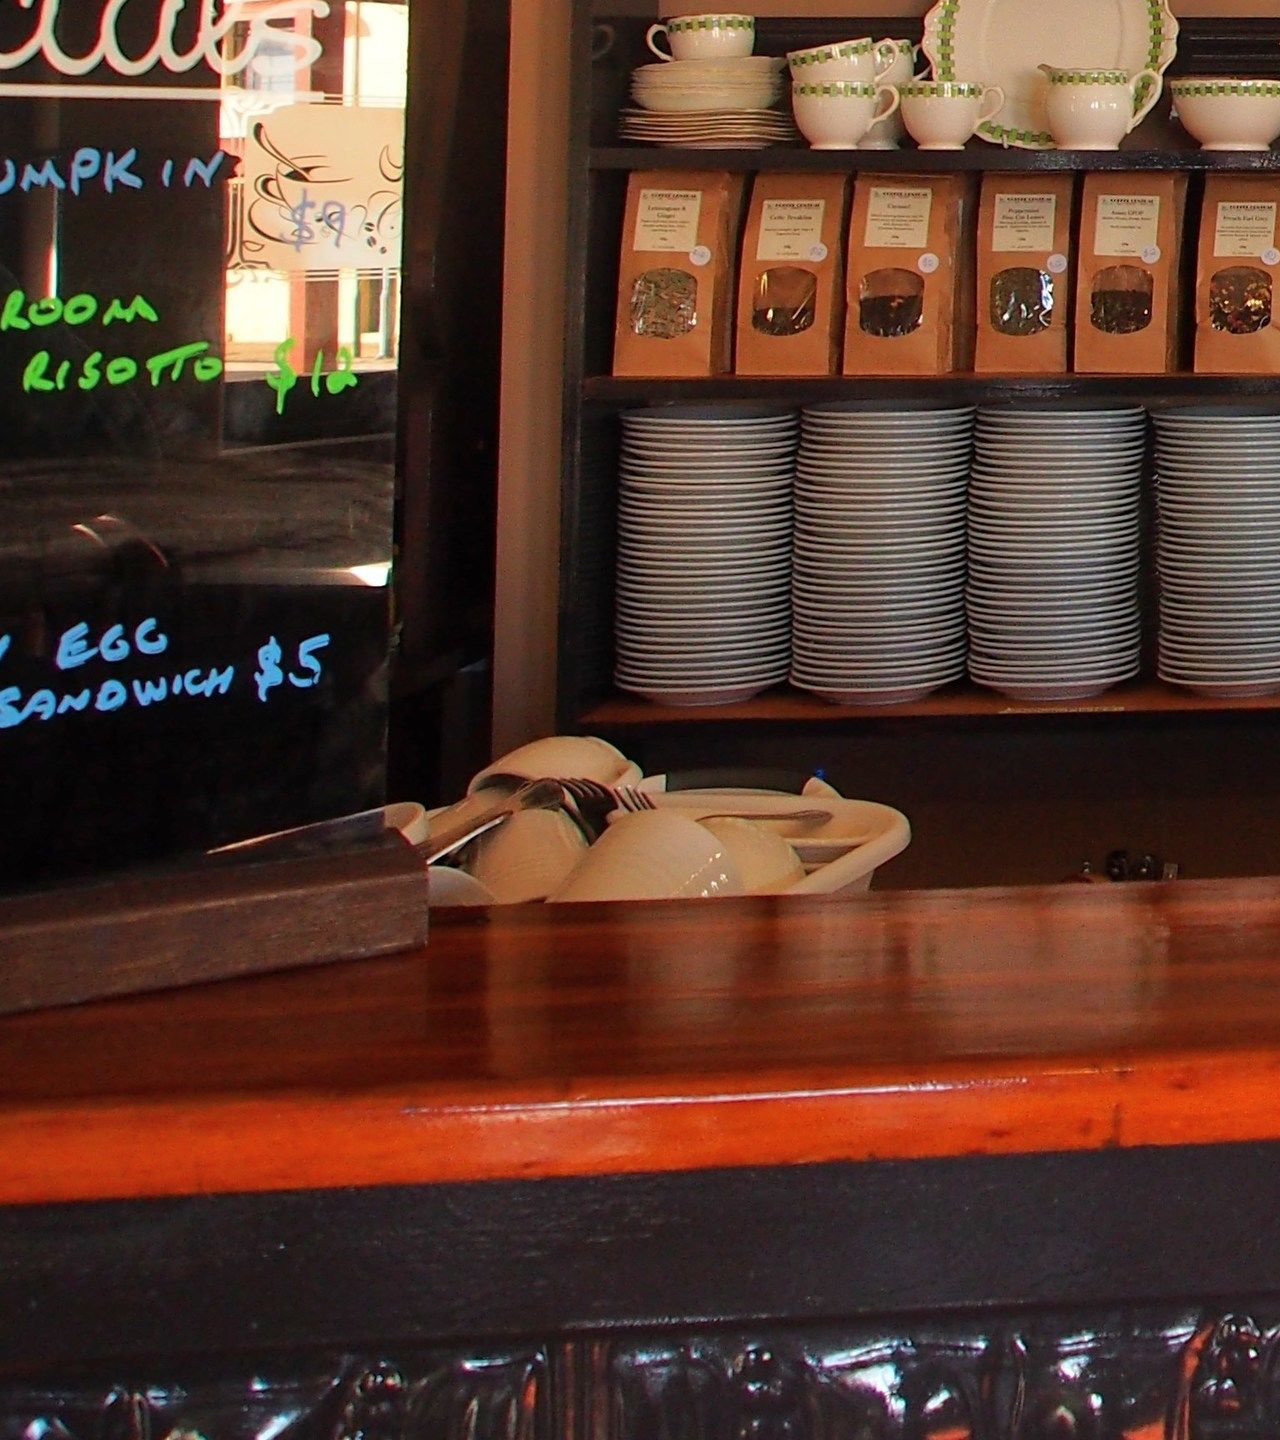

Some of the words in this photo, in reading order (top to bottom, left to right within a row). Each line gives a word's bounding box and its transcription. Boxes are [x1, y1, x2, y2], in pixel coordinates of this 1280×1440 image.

[0, 289, 159, 332] ROOM
[22, 341, 223, 392] RISOTTO
[266, 338, 358, 414] $12
[56, 617, 168, 671] EGG
[0, 665, 235, 728] SANDWICH
[254, 633, 331, 702] $5
